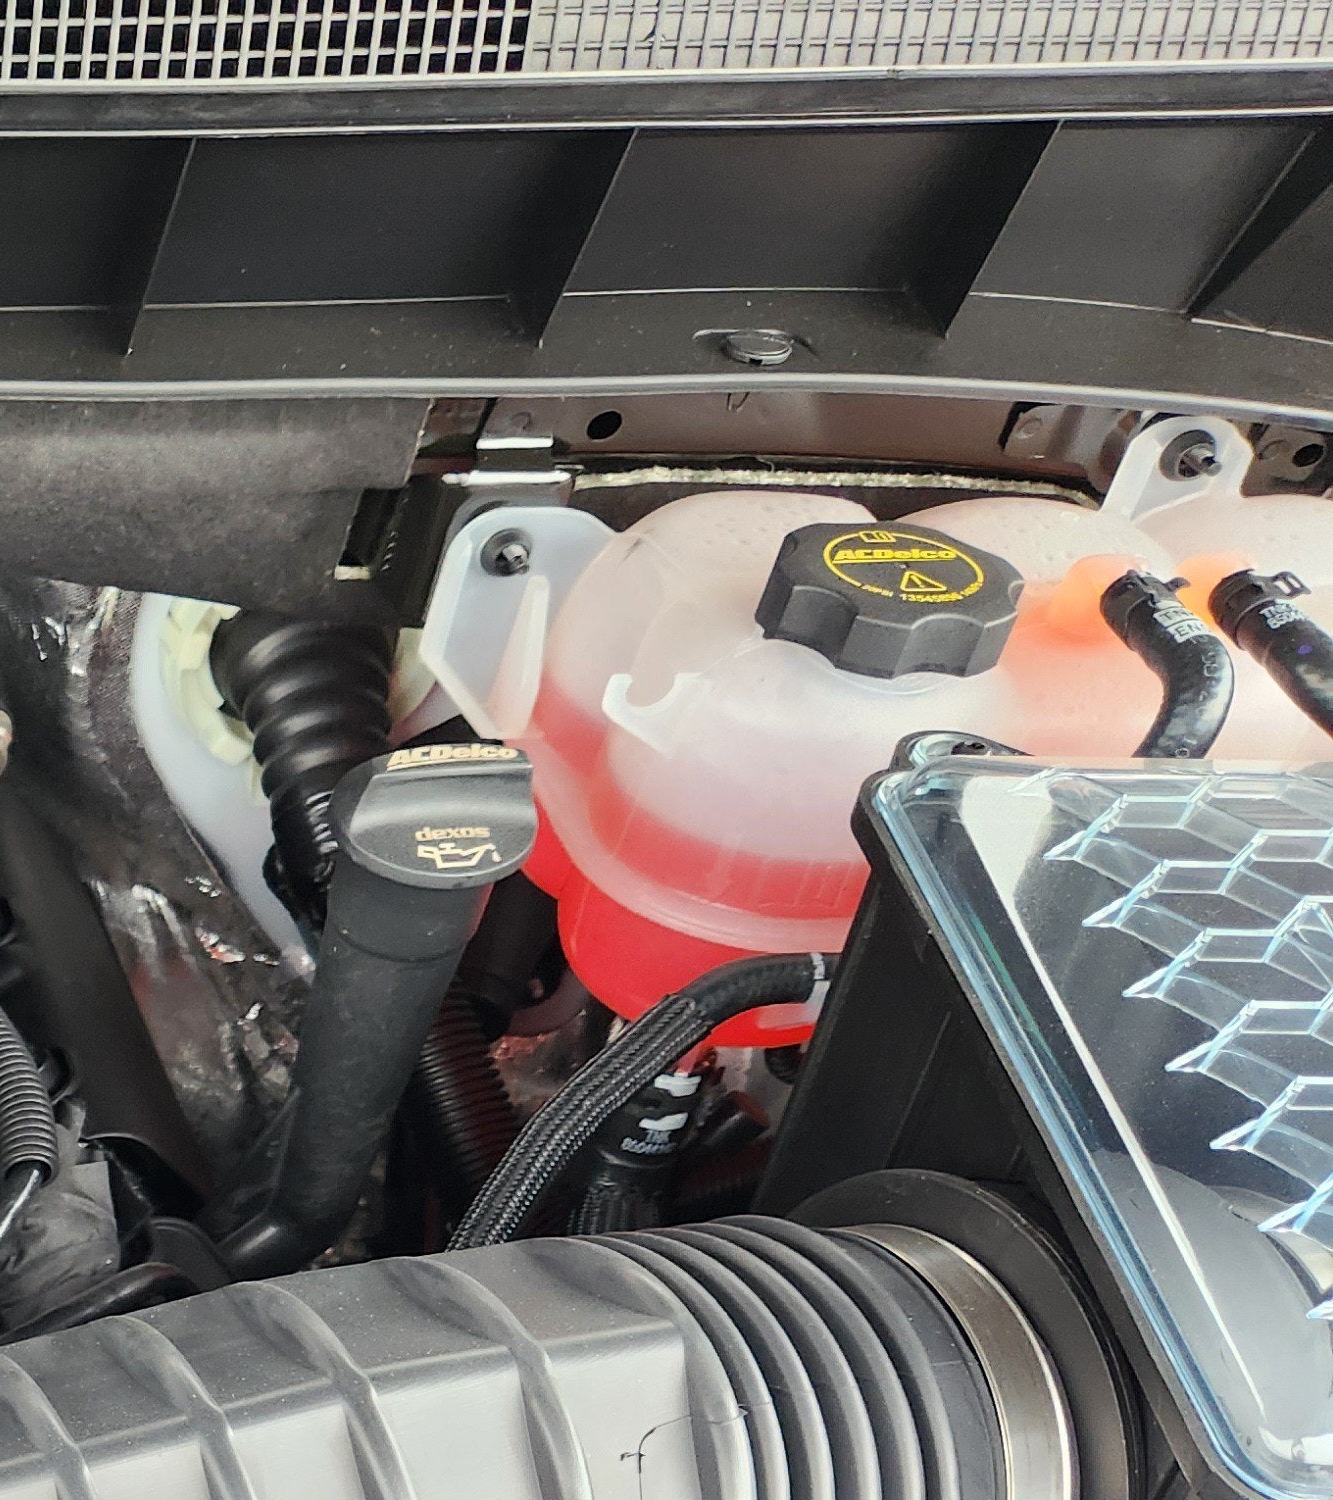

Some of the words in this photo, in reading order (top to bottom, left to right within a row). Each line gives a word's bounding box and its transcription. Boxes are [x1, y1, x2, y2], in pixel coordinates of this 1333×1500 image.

[833, 548, 957, 562] ACDelco
[386, 743, 519, 768] ACDelco
[415, 827, 490, 842] dexos
